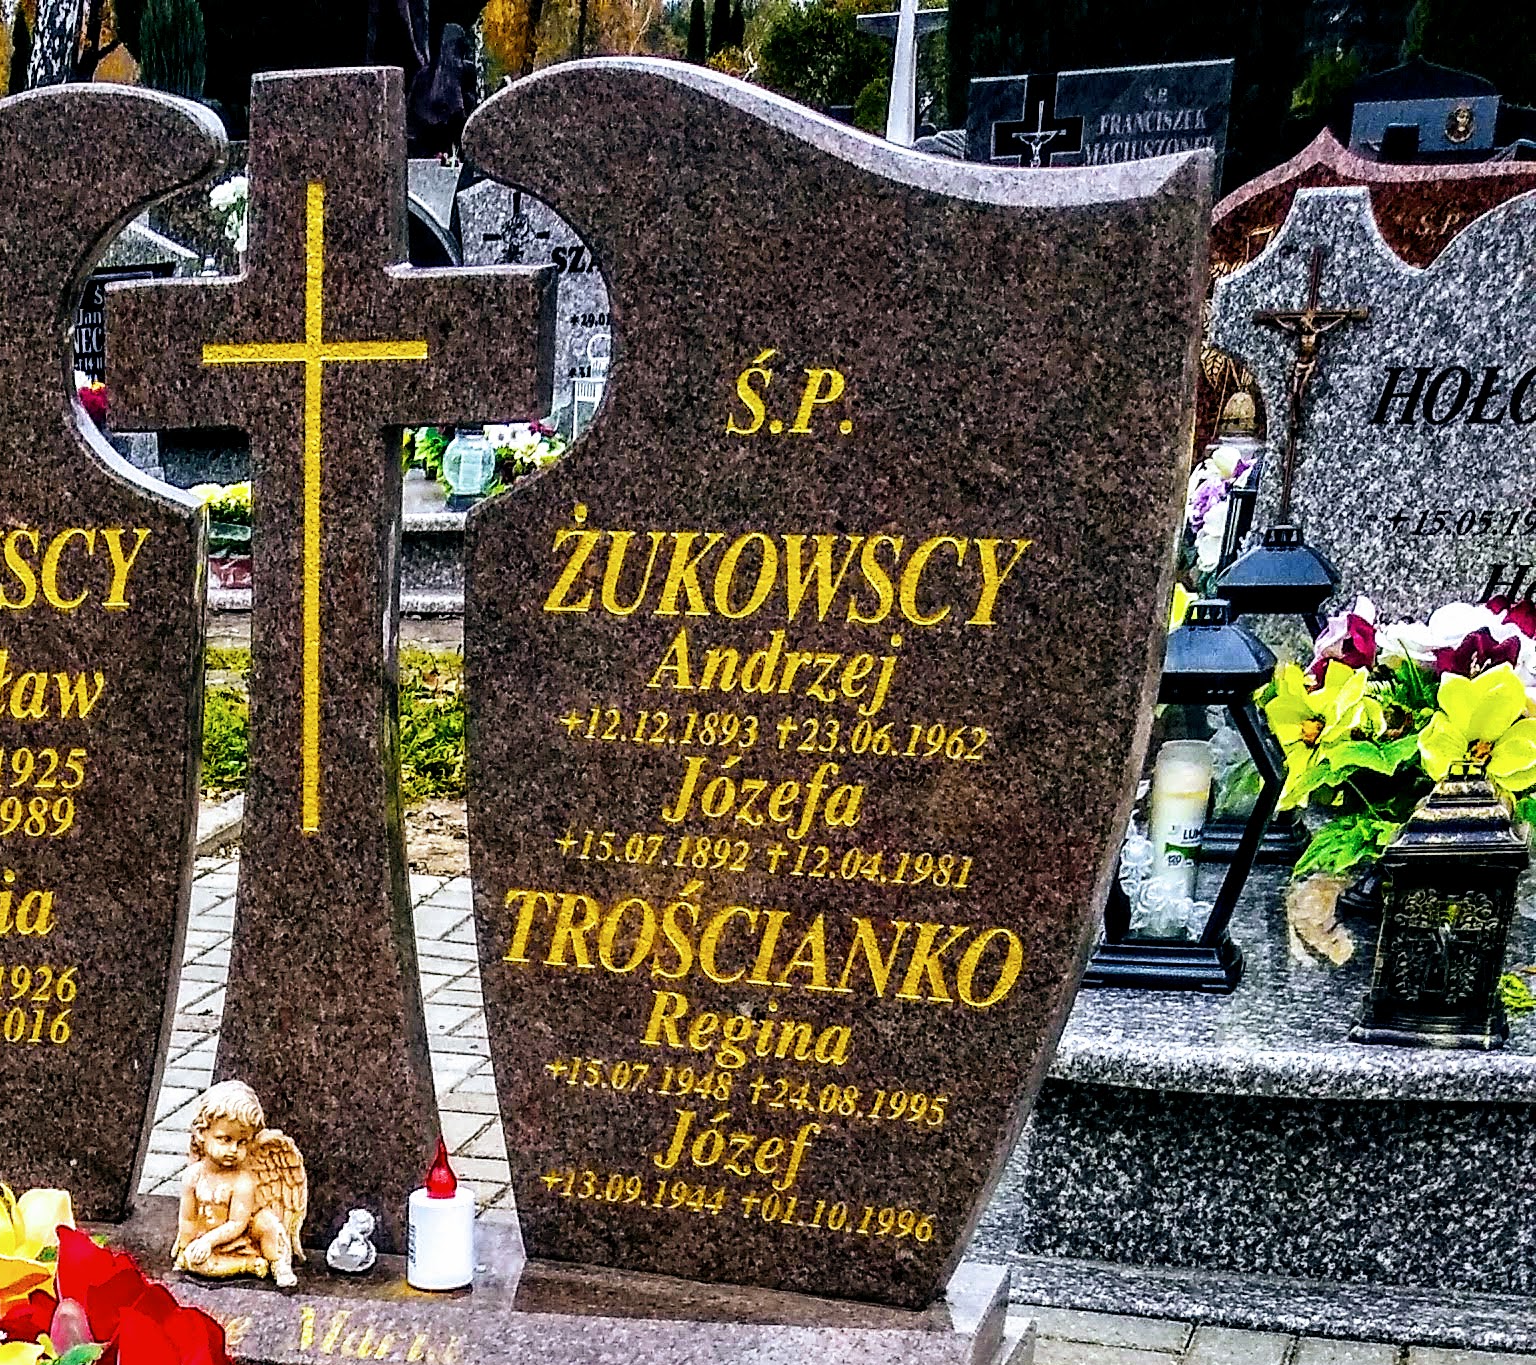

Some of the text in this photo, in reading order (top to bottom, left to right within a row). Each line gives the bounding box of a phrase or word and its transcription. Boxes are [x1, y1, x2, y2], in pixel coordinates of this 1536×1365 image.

[725, 348, 853, 435] Ś.P.
[543, 502, 1034, 627] ŻUKOWSCY
[646, 626, 904, 716] Andrzej
[662, 756, 865, 841] Józefa
[502, 879, 1026, 1010] TROŚCIANKO
[640, 989, 852, 1069] Regina
[654, 1108, 822, 1190] Józef
